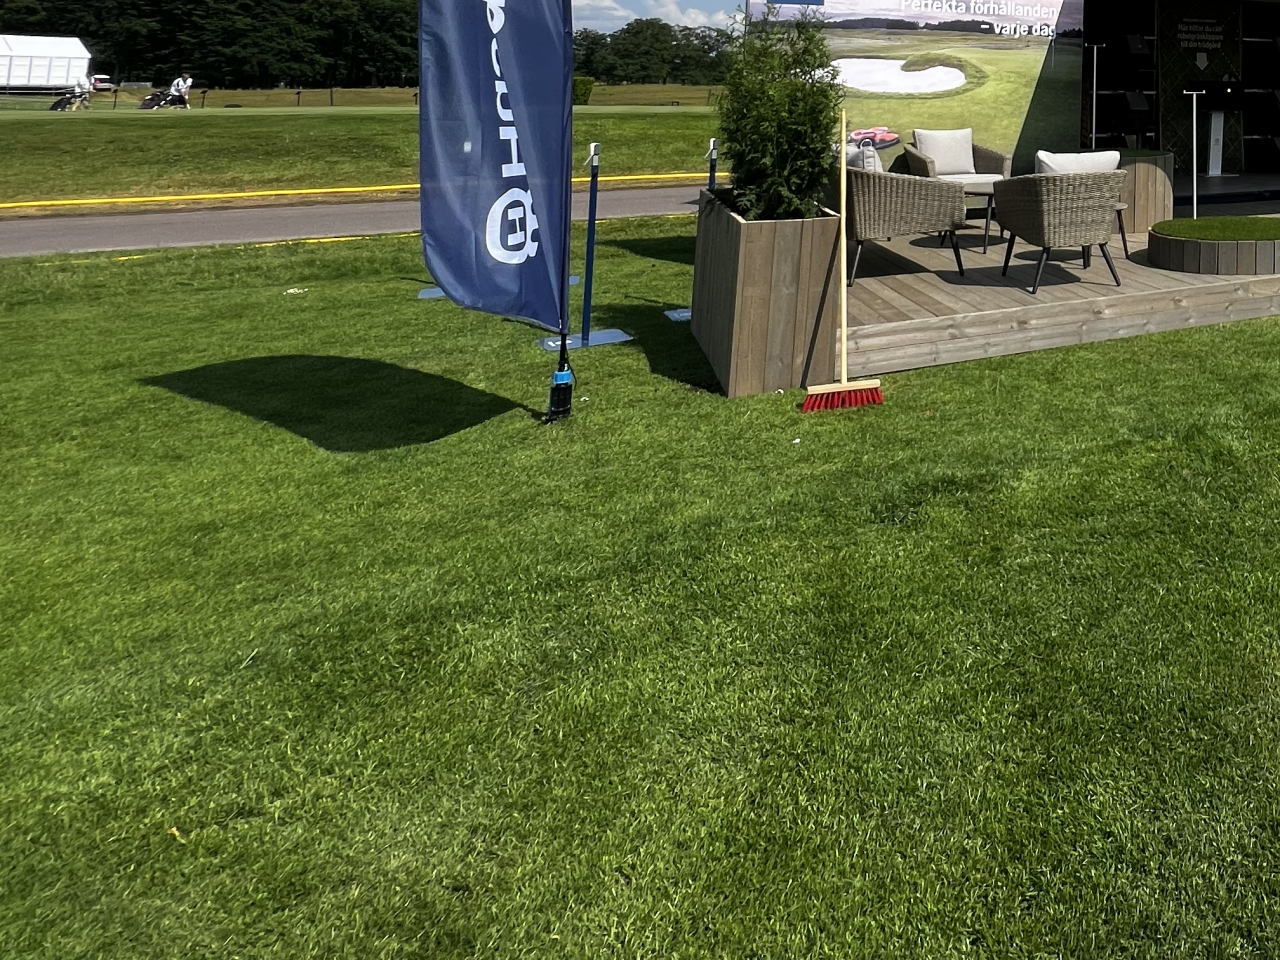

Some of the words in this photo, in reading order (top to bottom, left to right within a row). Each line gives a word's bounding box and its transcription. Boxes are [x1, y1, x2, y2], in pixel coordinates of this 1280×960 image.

[970, 0, 1059, 18] förhållanden
[993, 21, 1029, 38] varje
[1032, 23, 1057, 40] dag
